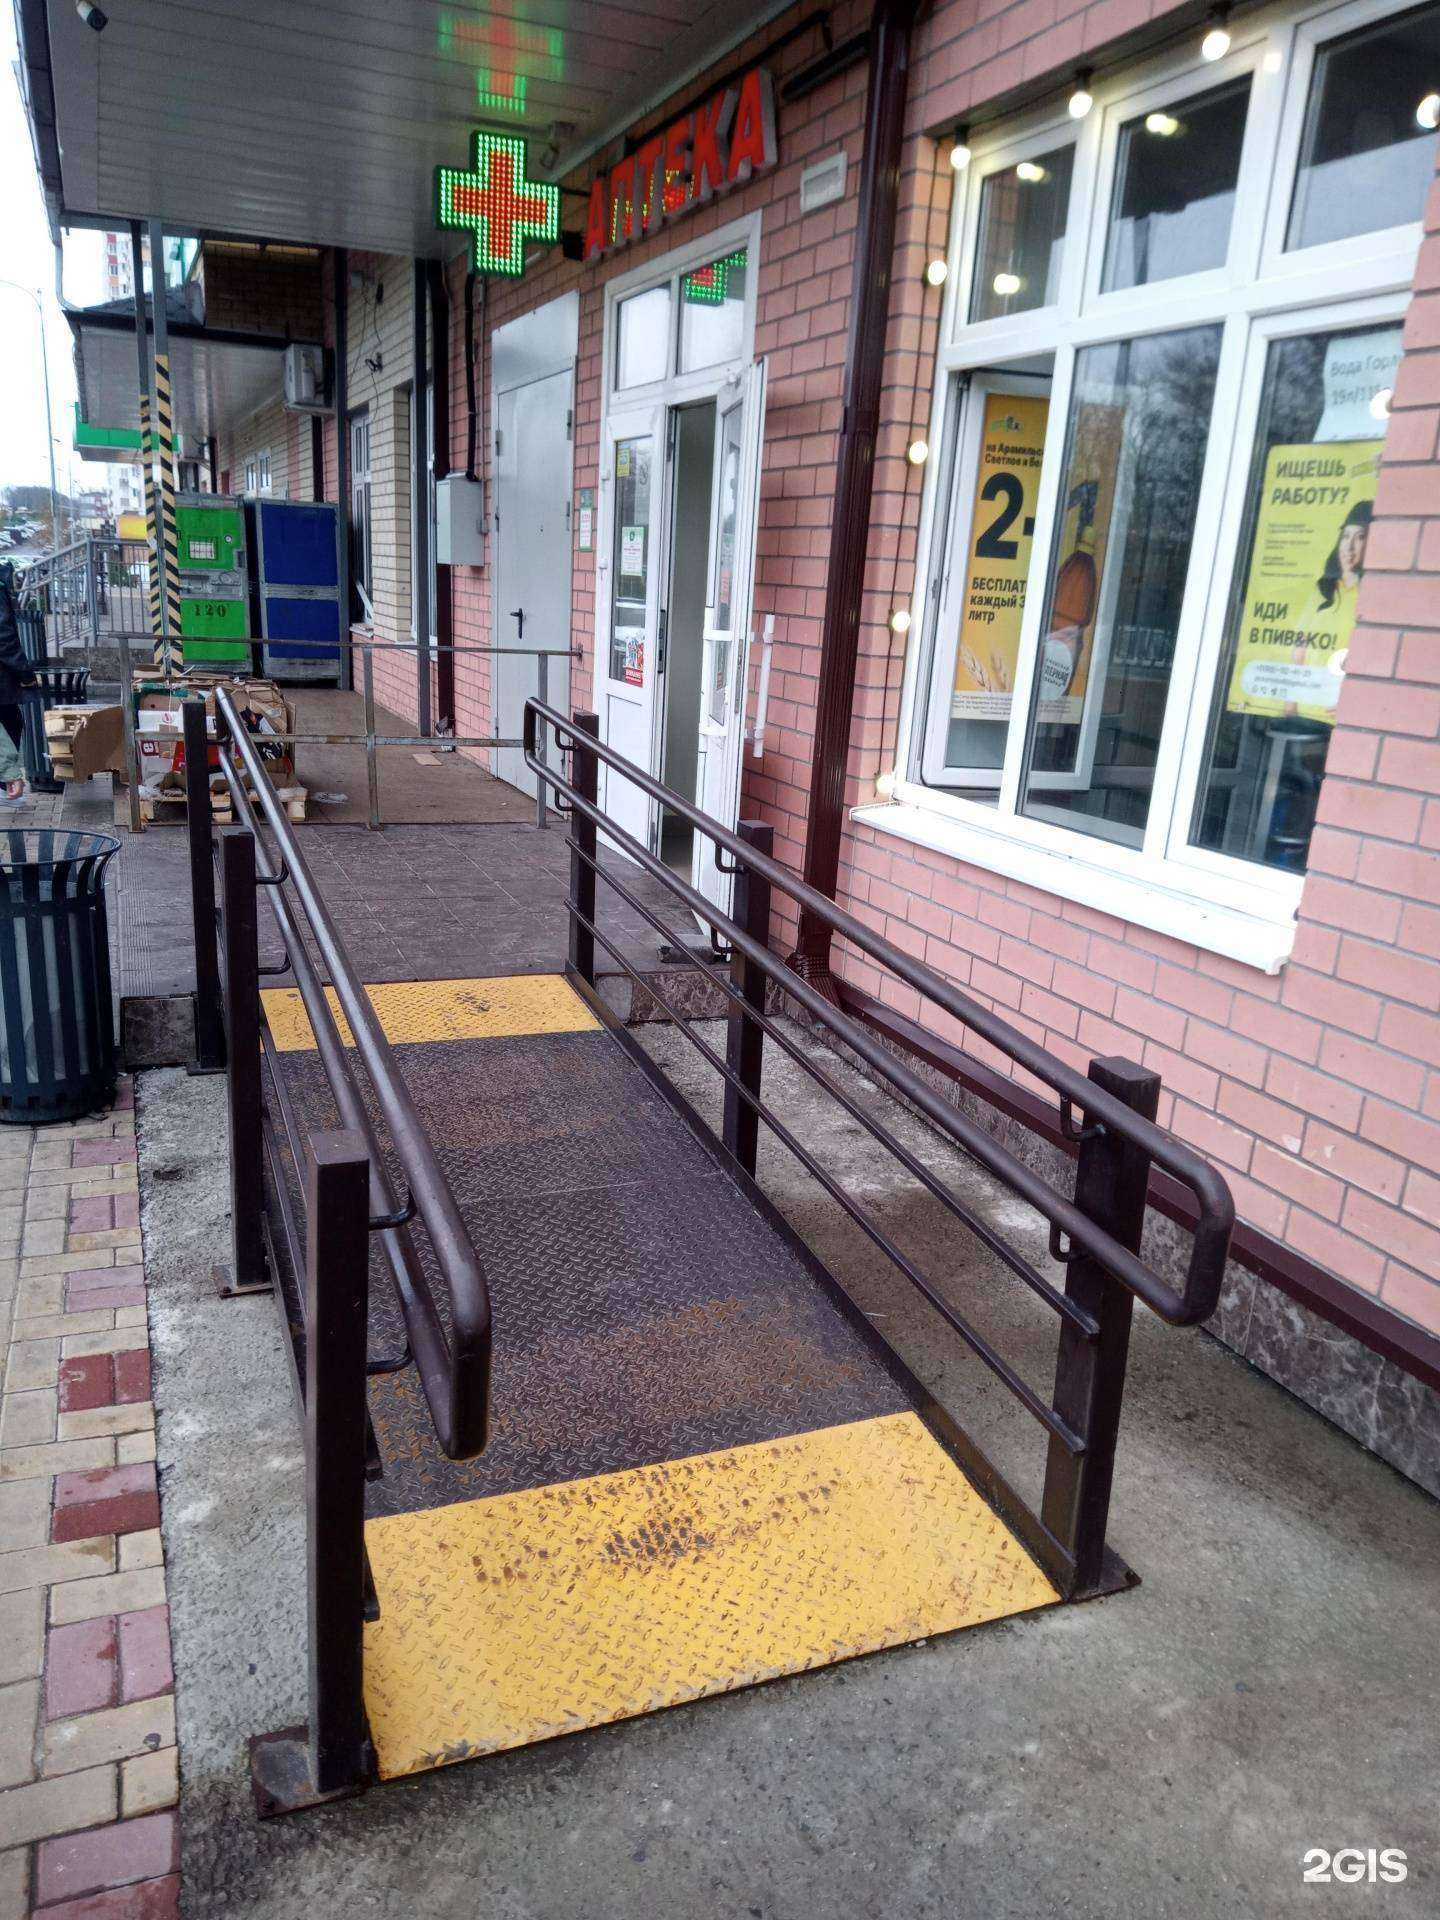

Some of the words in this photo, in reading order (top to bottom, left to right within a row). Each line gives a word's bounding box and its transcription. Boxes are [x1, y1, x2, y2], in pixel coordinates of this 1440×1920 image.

[583, 66, 774, 262] АПТЕКА
[998, 443, 1044, 457] Арамильс
[1276, 459, 1346, 481] ИЩЕШЬ
[1271, 486, 1350, 506] РАБОТУ?
[194, 605, 227, 618] 120
[970, 594, 1017, 610] каждый
[1254, 602, 1288, 622] ИДИ
[968, 609, 995, 625] литр
[1249, 627, 1260, 644] В
[1262, 628, 1338, 650] ПИВ&КО!
